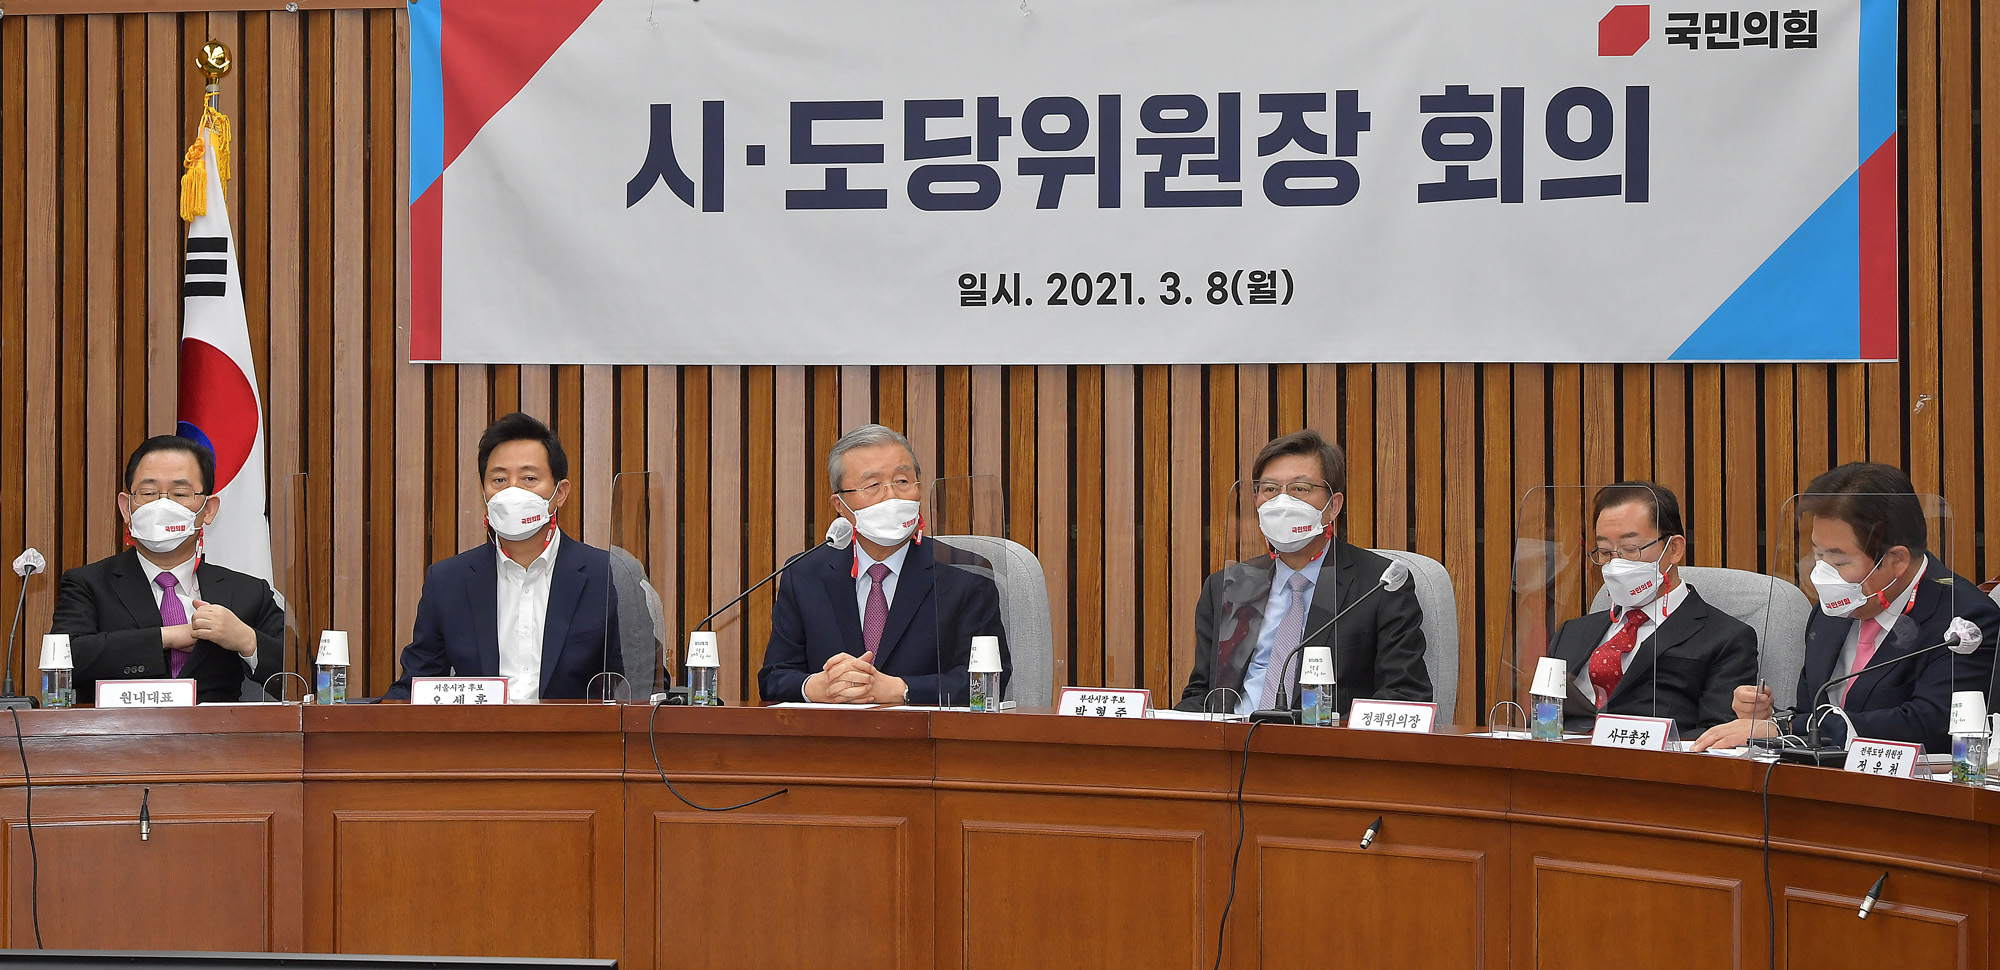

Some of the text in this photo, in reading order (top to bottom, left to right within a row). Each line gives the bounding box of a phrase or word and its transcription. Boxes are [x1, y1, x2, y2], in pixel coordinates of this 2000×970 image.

[1664, 9, 1818, 50] 국민의힘
[626, 84, 1650, 213] 시·도당위원장 회의
[958, 268, 1294, 307] 일시. 2021. 3. 8(월)
[1629, 580, 1653, 596] 국민의힘
[433, 683, 466, 692] 서울시장
[119, 690, 174, 704] 원내대표
[1079, 694, 1126, 704] 부산시장 후보
[1361, 711, 1421, 729] 정책위의장
[1606, 728, 1651, 746] 사무총장
[1884, 748, 1903, 760] 위원장
